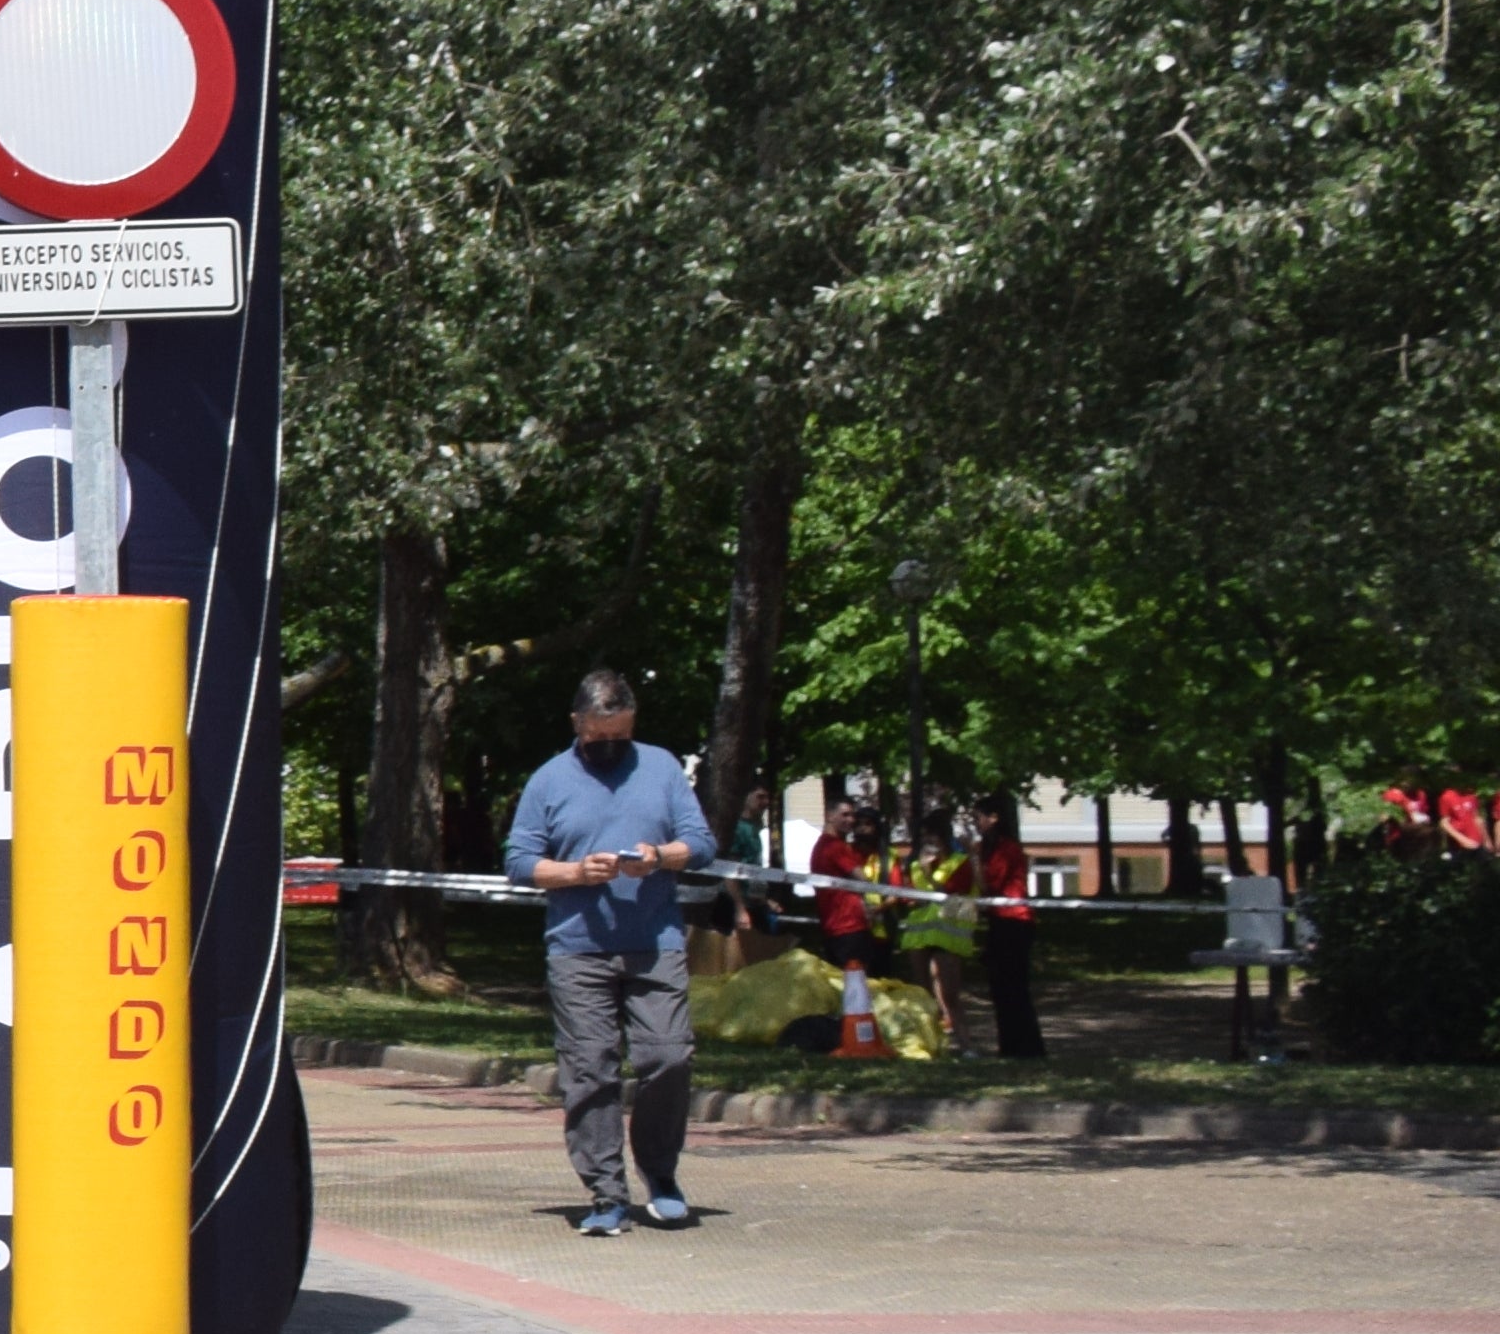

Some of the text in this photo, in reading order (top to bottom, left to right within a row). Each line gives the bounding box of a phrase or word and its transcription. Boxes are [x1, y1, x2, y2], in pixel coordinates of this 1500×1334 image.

[2, 241, 190, 266] EXCEPTO SERVICIOS,
[121, 267, 214, 289] CICLISTAS
[105, 745, 175, 1147] MONDO
